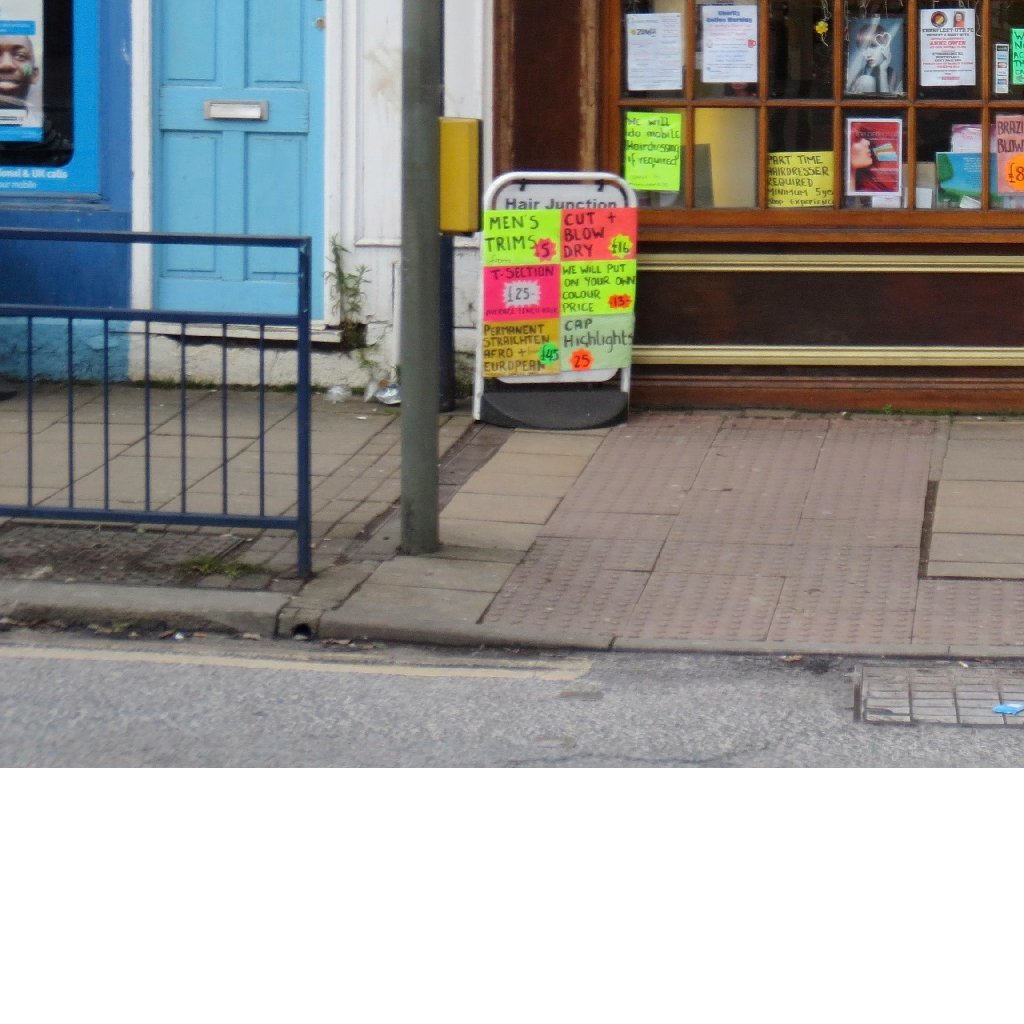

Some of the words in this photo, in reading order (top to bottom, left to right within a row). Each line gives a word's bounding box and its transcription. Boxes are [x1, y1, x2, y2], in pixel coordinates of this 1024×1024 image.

[627, 128, 641, 137] do
[768, 155, 792, 165] PART
[797, 155, 823, 165] TIME
[47, 168, 68, 179] calls
[768, 166, 829, 177] HAIRDRESSER
[768, 177, 813, 188] REQUIRED
[505, 198, 540, 210] Hair
[545, 198, 617, 210] Junction
[564, 212, 595, 226] CUT
[564, 227, 604, 242] BLOW
[485, 235, 537, 253] TRIMS
[611, 242, 630, 255] £16
[563, 244, 593, 259] DRY
[505, 265, 554, 280] SECTION
[562, 265, 577, 275] WE
[579, 264, 602, 274] WILL
[607, 263, 626, 273] PUT
[564, 278, 579, 287] ON
[584, 276, 610, 287] YOUR
[615, 276, 636, 286] OWN
[562, 290, 600, 300] COLOUR
[562, 302, 594, 313] PRICE
[484, 324, 544, 337] PERMANENT
[564, 318, 592, 331] CAP
[563, 329, 634, 353] Highlights
[484, 348, 513, 359] AFRO
[484, 359, 545, 372] EUROPEAN
[574, 354, 591, 369] 25
